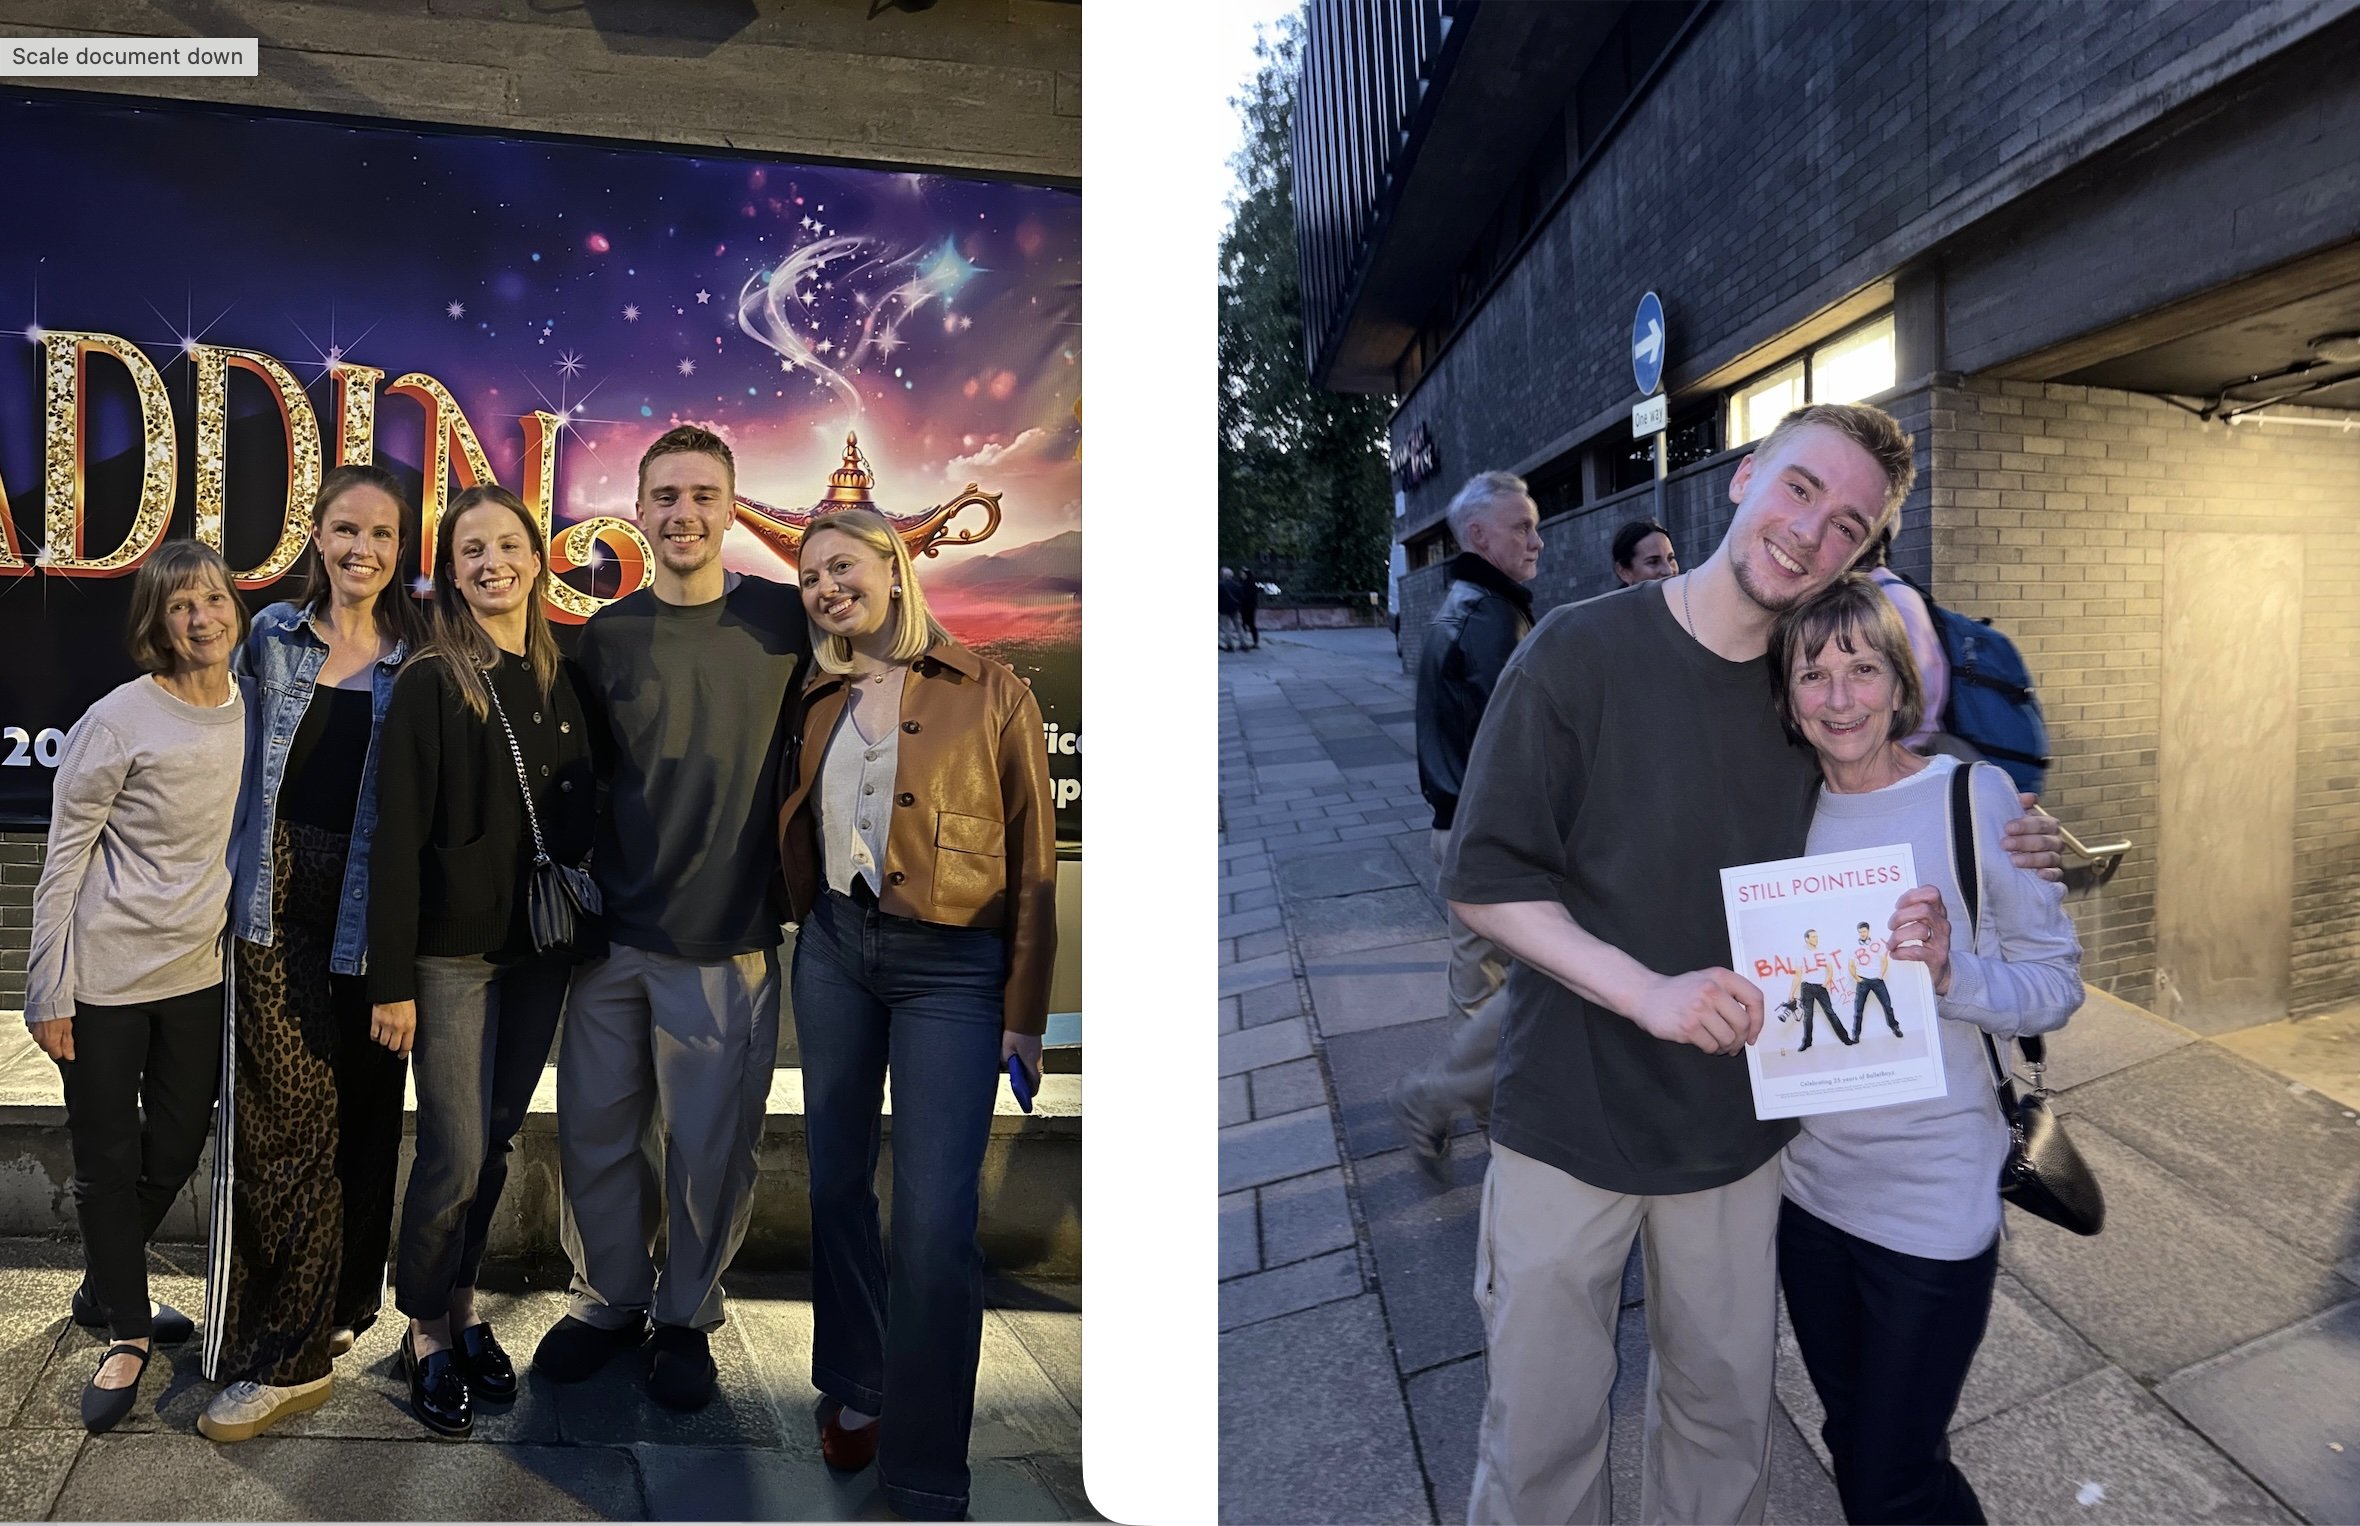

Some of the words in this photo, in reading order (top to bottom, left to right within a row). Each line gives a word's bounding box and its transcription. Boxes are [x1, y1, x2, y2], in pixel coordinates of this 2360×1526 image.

[1635, 412, 1648, 428] One
[1650, 407, 1663, 423] way
[0, 329, 656, 625] DDIN
[1, 726, 66, 768] 20
[1738, 880, 1786, 903] STILL
[1793, 865, 1902, 896] POINTLESS
[1754, 948, 1842, 978] BALLET
[1827, 976, 1846, 995] AT
[1800, 1078, 1832, 1087] Celebrating
[1859, 1073, 1865, 1081] of
